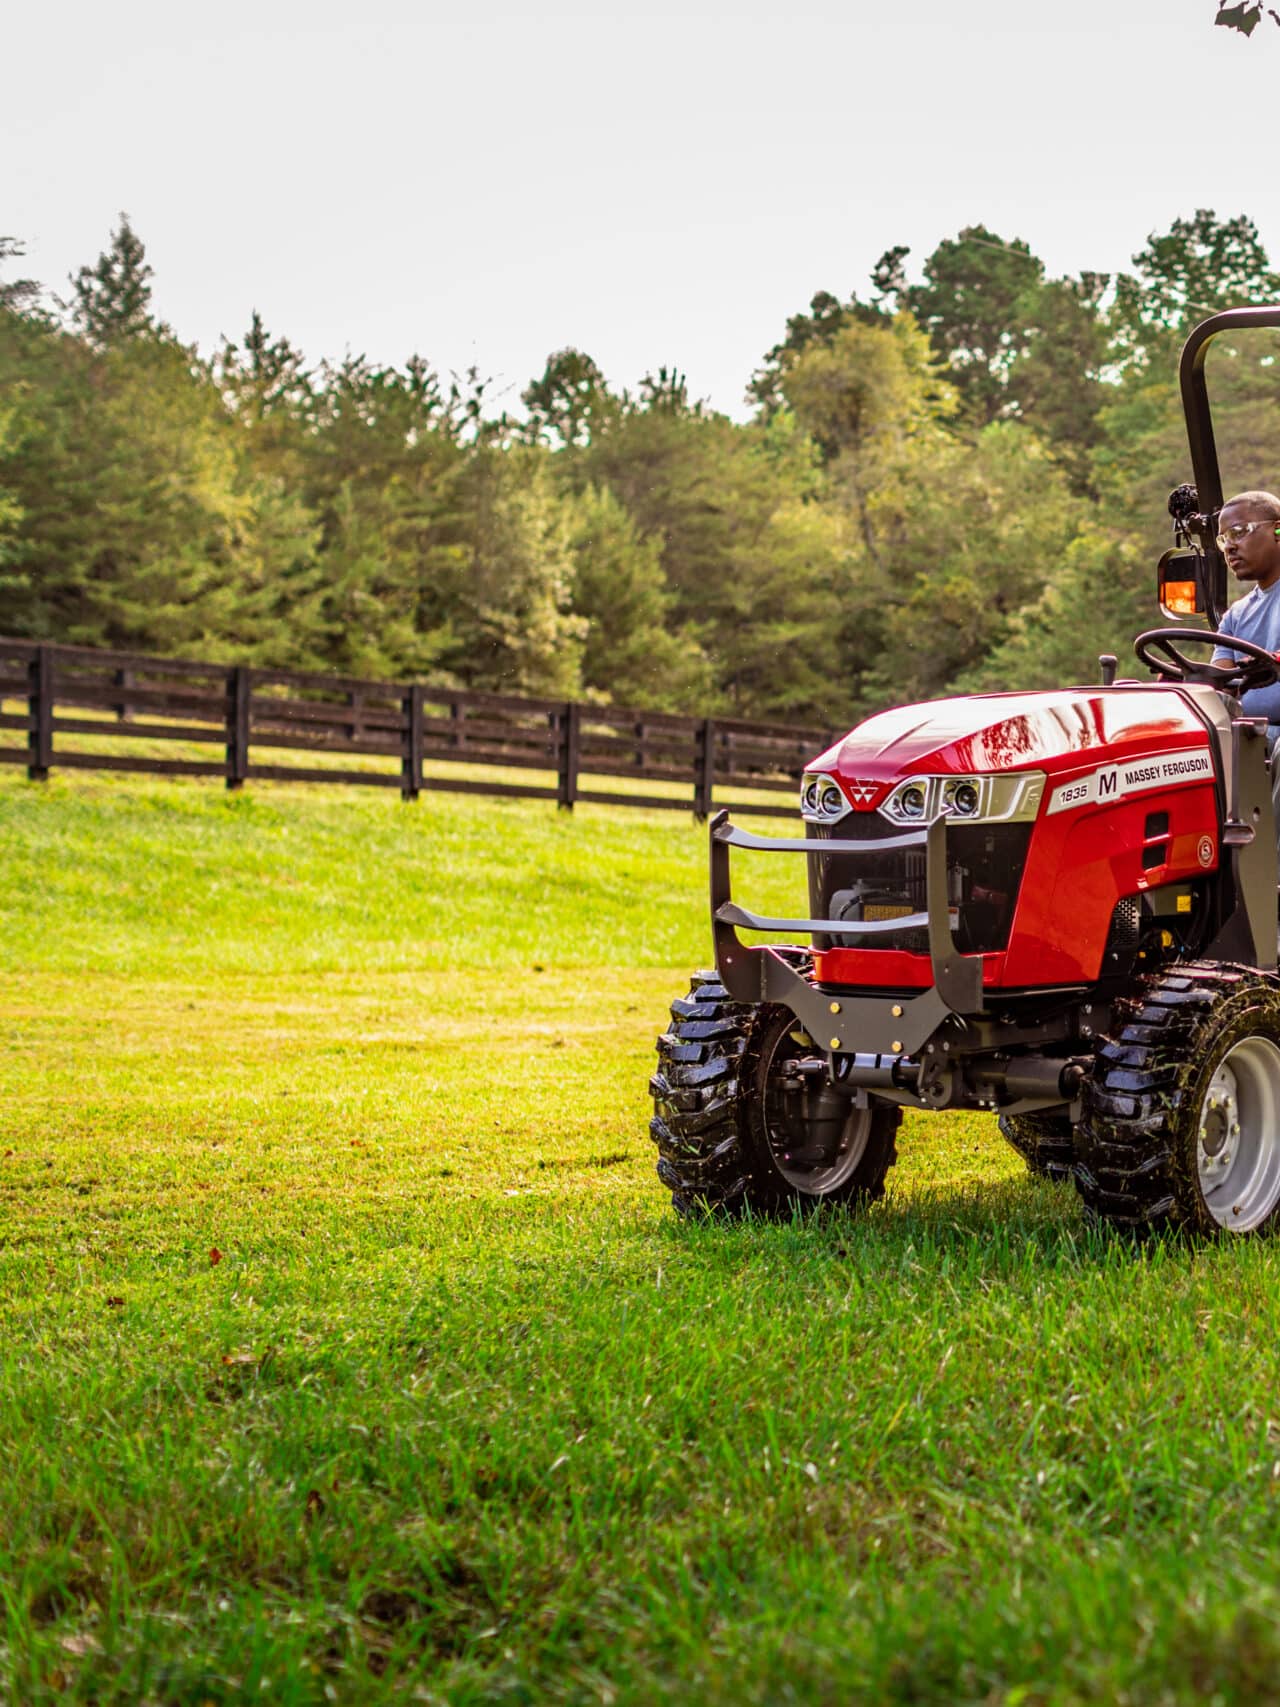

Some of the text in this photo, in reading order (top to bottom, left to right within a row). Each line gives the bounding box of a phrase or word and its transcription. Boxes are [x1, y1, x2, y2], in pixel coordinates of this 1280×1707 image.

[1099, 771, 1117, 796] M
[1125, 758, 1209, 784] MASSEY FERGUSON
[1060, 785, 1087, 803] 1835
